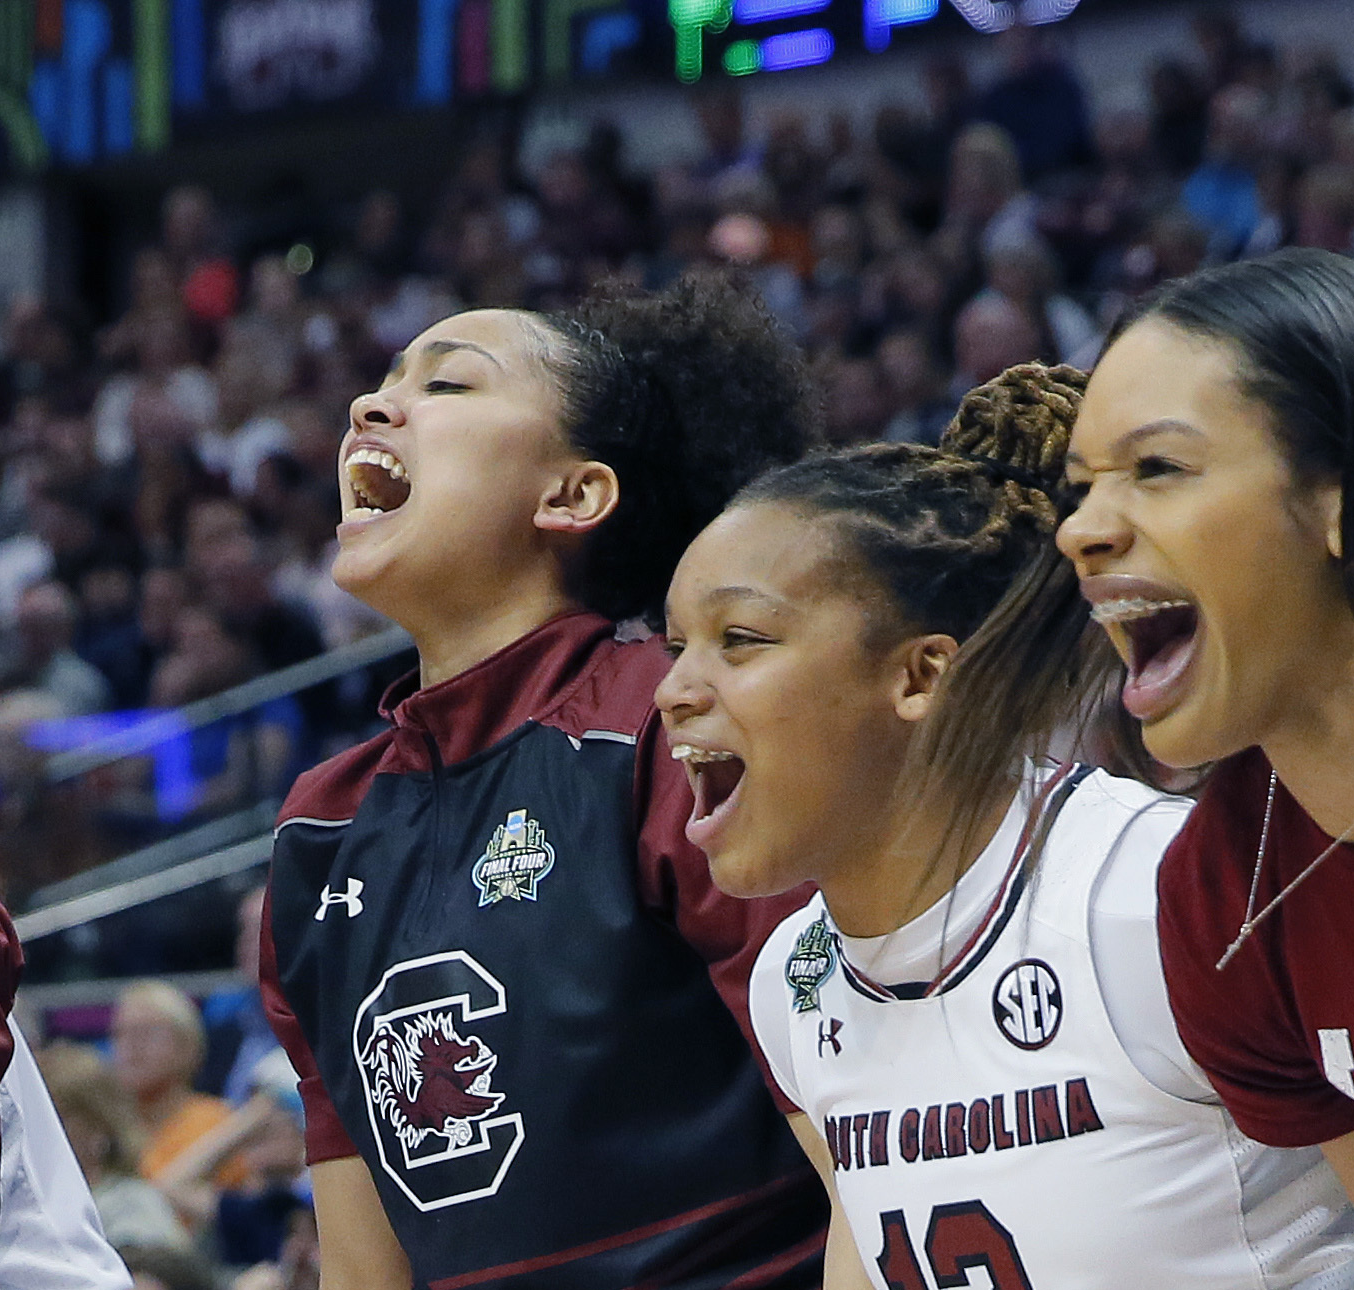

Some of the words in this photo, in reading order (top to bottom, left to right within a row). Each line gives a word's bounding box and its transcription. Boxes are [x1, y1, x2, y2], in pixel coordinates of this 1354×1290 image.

[511, 852, 546, 872] FOUR
[996, 964, 1059, 1044] SEC
[824, 1110, 891, 1171] OUTH
[899, 1077, 1104, 1163] CAROLINA
